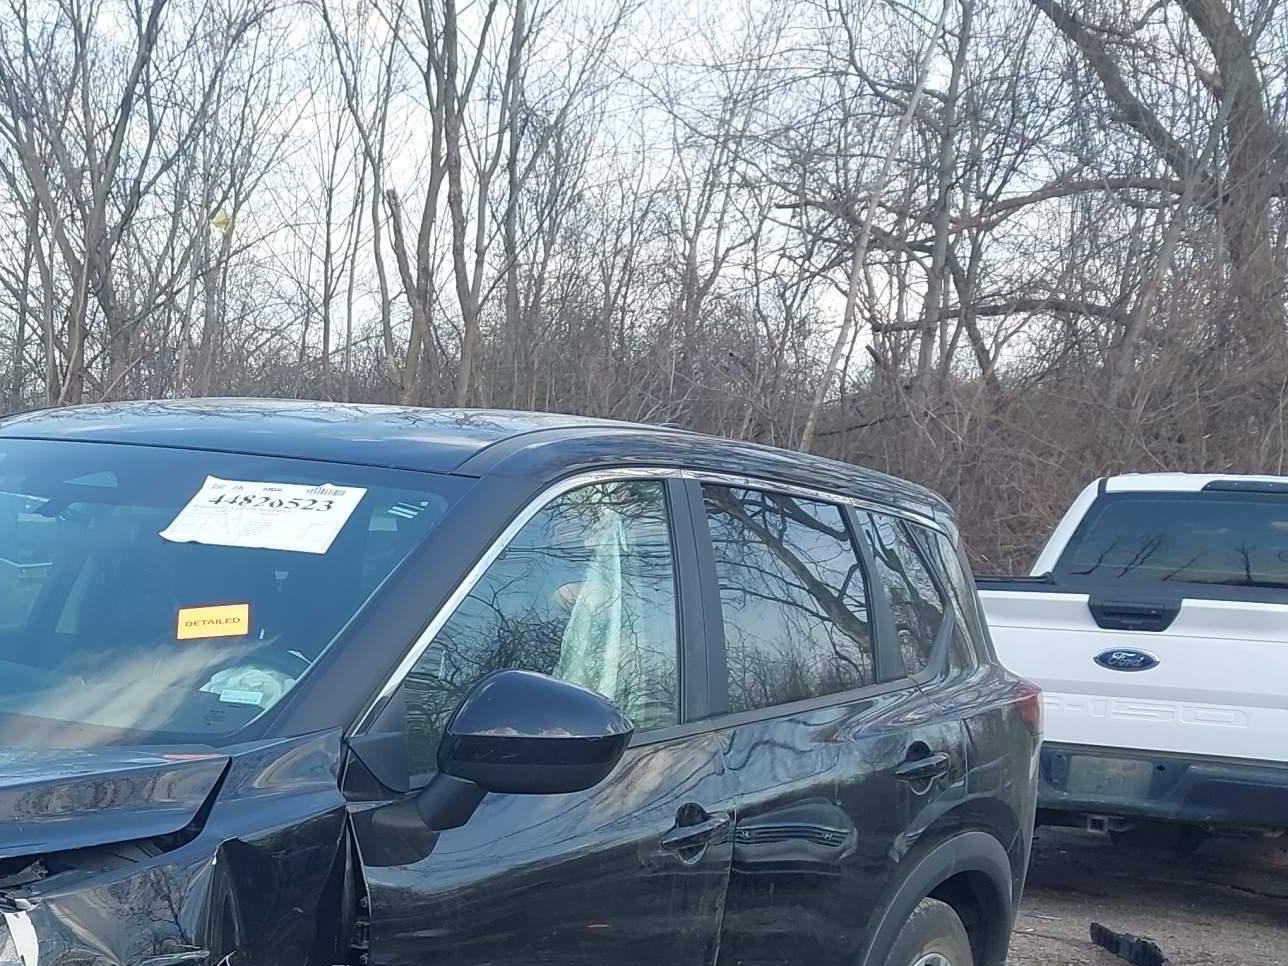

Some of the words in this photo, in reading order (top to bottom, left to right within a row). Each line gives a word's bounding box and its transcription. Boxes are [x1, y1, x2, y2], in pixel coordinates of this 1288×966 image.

[184, 617, 241, 627] DETAILED
[1108, 651, 1145, 668] Ford
[1043, 694, 1251, 729] -150
